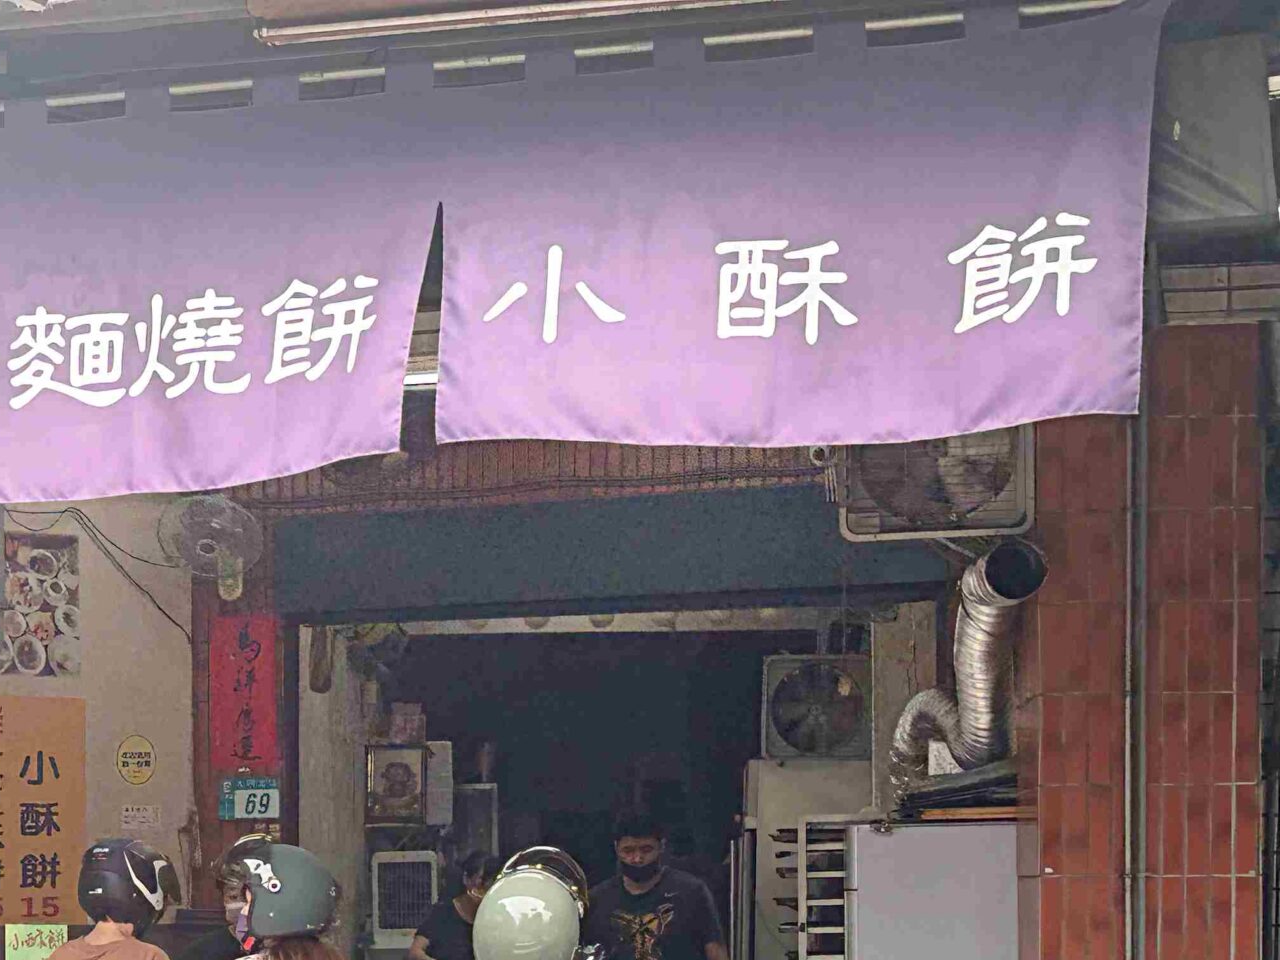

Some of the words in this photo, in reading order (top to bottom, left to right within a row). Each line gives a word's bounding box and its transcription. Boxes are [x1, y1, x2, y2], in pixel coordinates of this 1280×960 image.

[483, 212, 1098, 344] 小酥餅
[20, 751, 61, 890] 小酥餅
[245, 793, 270, 815] 69
[21, 897, 60, 919] 15
